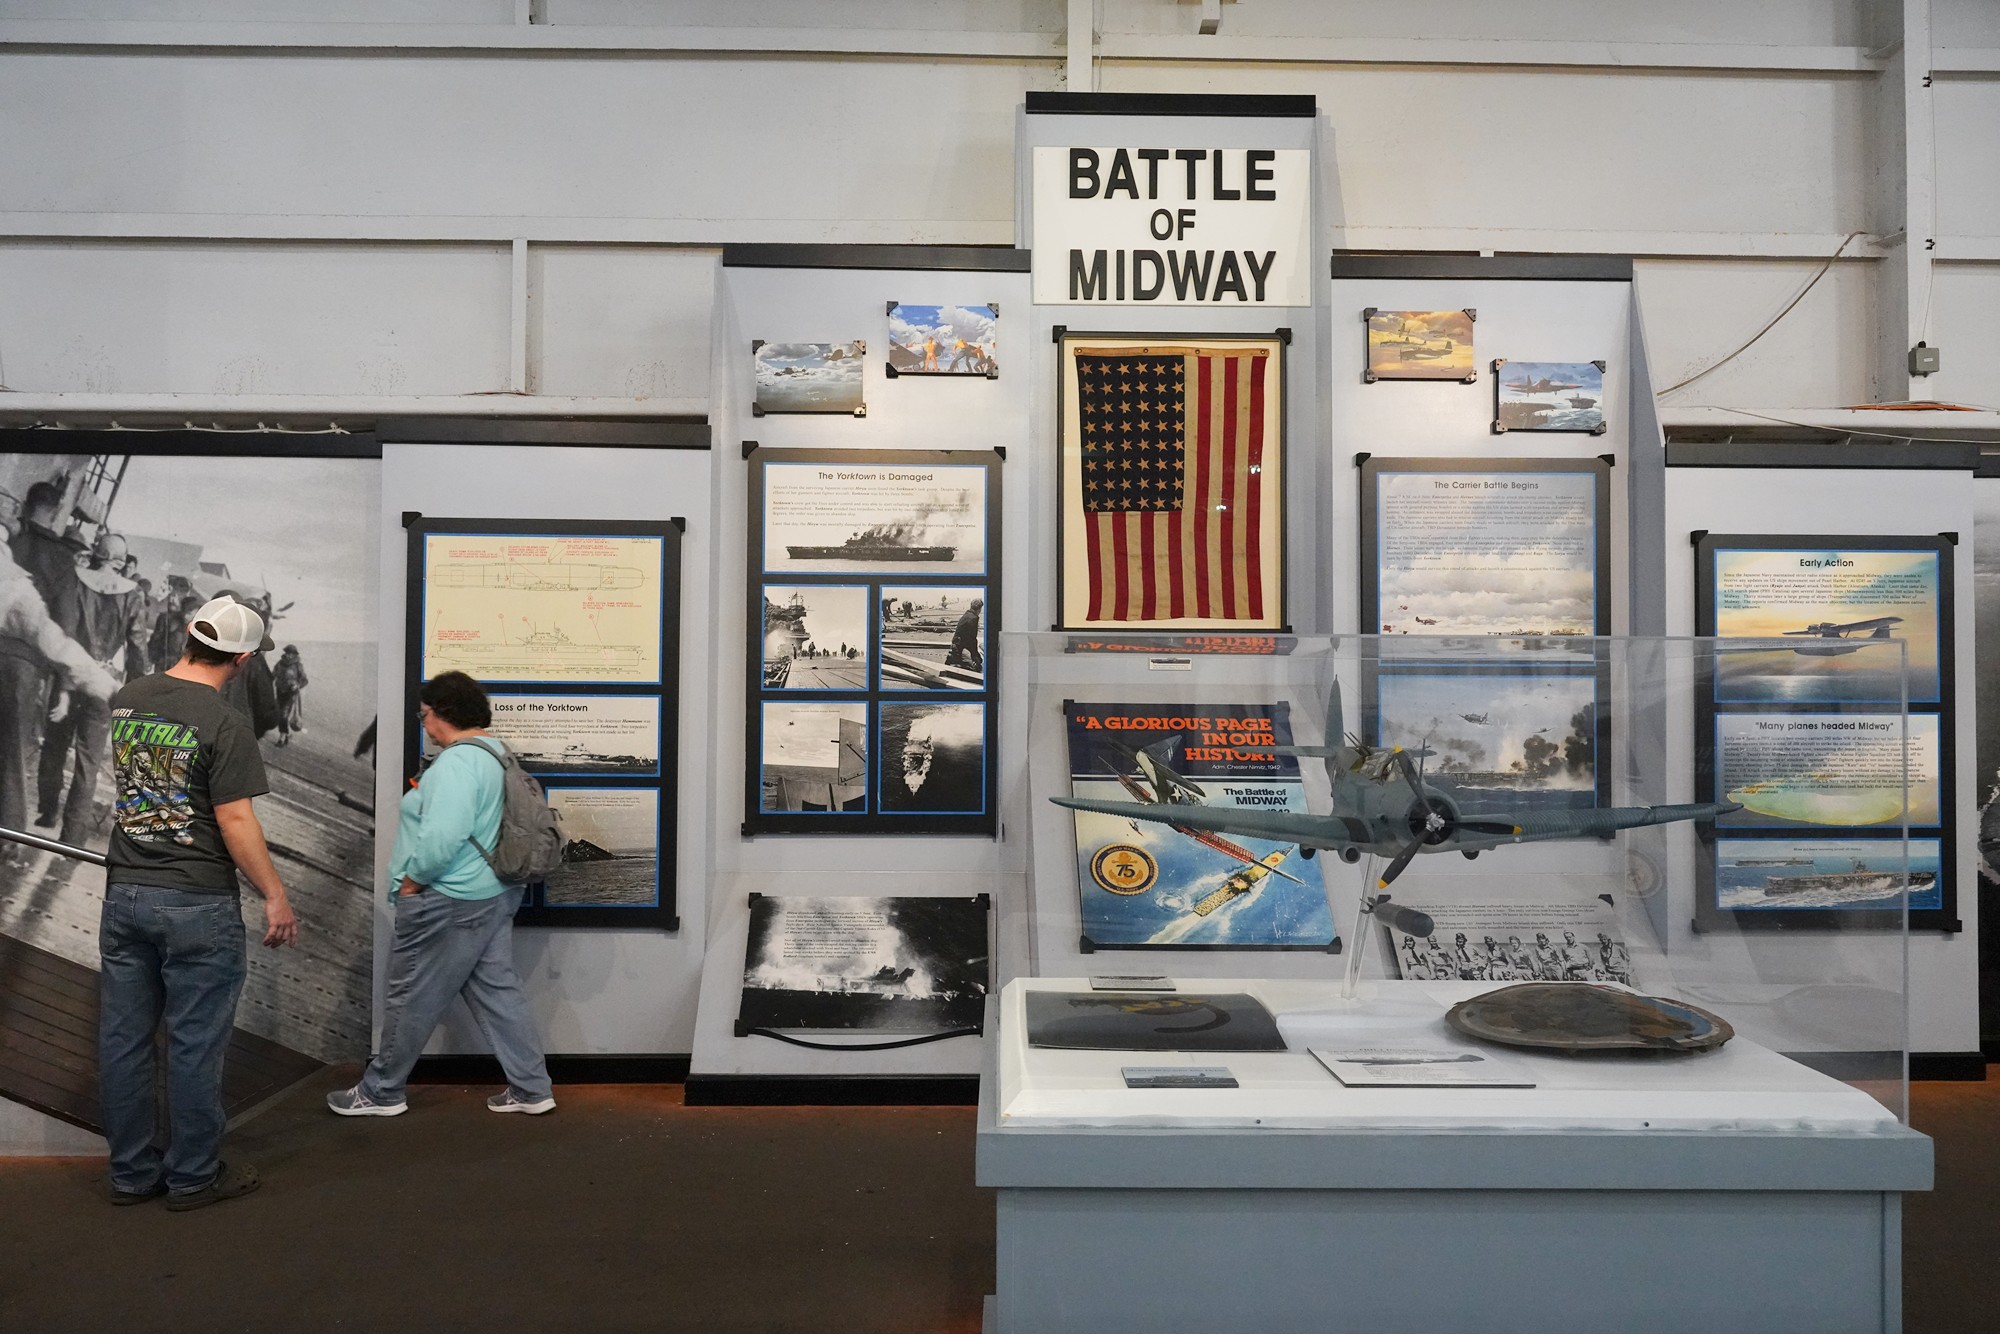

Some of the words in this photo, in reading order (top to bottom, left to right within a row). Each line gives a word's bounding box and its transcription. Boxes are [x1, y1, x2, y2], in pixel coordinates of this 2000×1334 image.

[1069, 148, 1276, 200] BATTLE
[1150, 208, 1196, 240] OF
[1069, 249, 1276, 301] MIDWAY
[818, 472, 834, 480] The
[836, 472, 876, 481] Yorktown
[879, 472, 886, 481] is
[888, 473, 933, 482] Damaged
[1434, 481, 1449, 489] The
[1512, 481, 1539, 490] Begins
[1800, 558, 1822, 568] Early
[1824, 558, 1854, 567] Action
[495, 704, 514, 712] Loss
[517, 704, 526, 712] of
[529, 704, 544, 712] the
[547, 704, 588, 712] Yorktown
[1076, 716, 1102, 729] “A
[1104, 716, 1212, 730] GLORIOUS
[1215, 718, 1273, 731] PAGE
[1755, 722, 1784, 731] "Many
[1788, 722, 1818, 732] planes
[1821, 722, 1855, 730] headed
[1858, 722, 1894, 732] Midway"
[1202, 733, 1227, 745] IN
[1229, 733, 1275, 746] OUR
[1236, 797, 1288, 805] MIDWAY
[1116, 864, 1135, 878] 75
